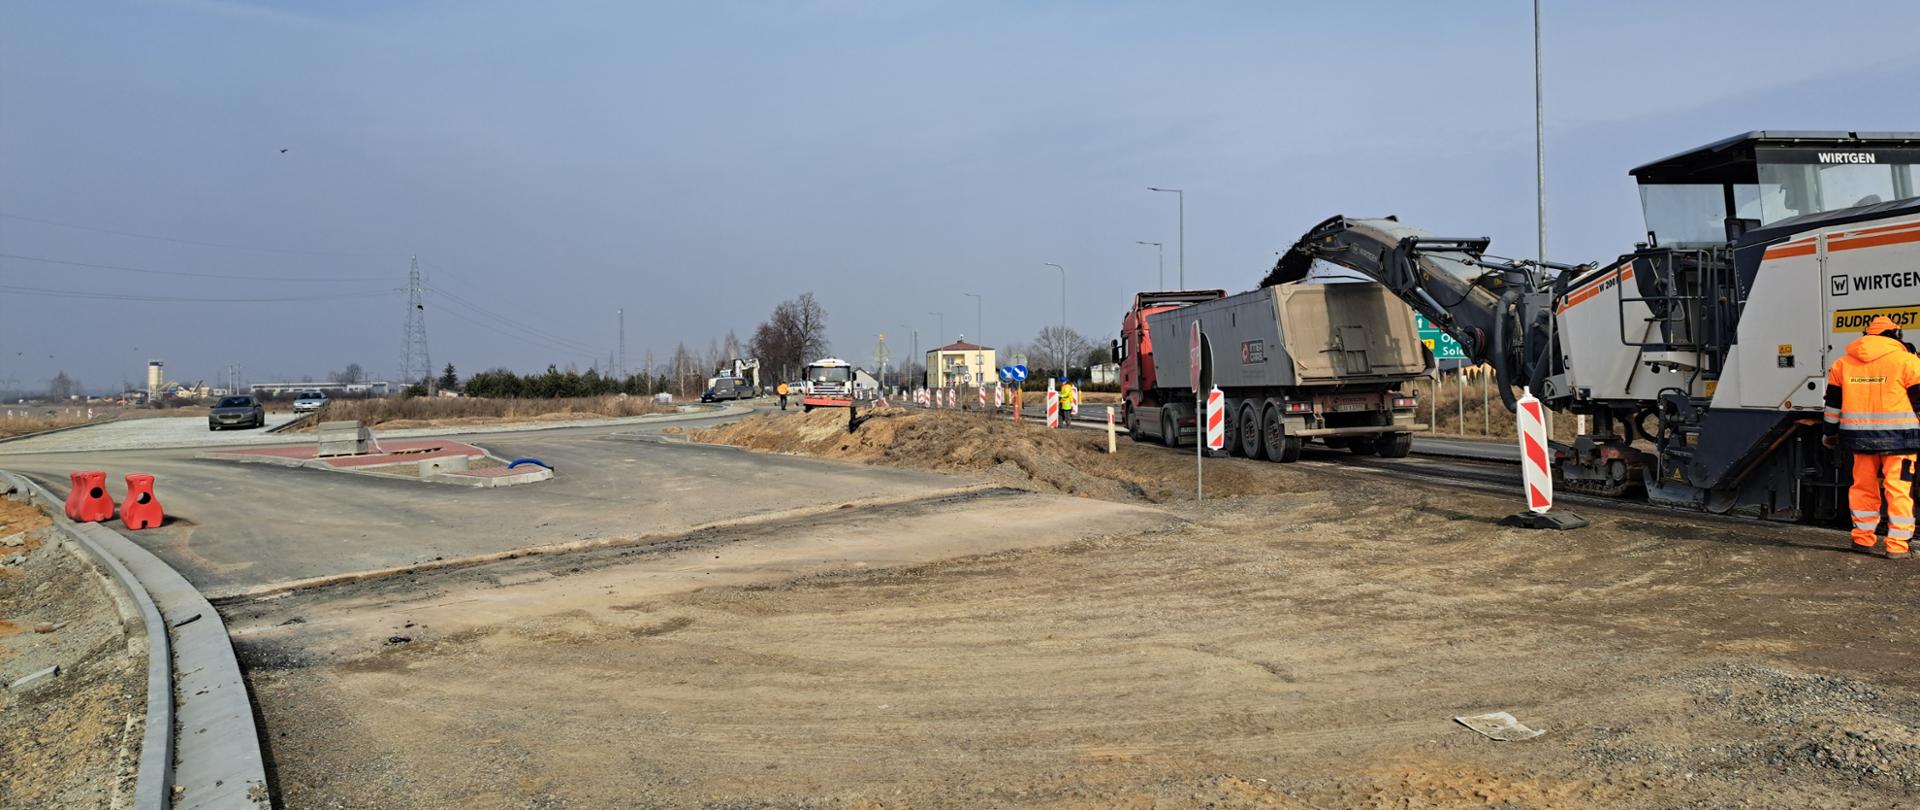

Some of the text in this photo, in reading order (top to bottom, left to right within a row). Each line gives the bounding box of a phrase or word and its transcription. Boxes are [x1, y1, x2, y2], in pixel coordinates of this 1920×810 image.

[1818, 152, 1876, 164] WIRTGEN
[1853, 271, 1920, 292] WIRTGEN
[1835, 311, 1918, 328] BUDROST
